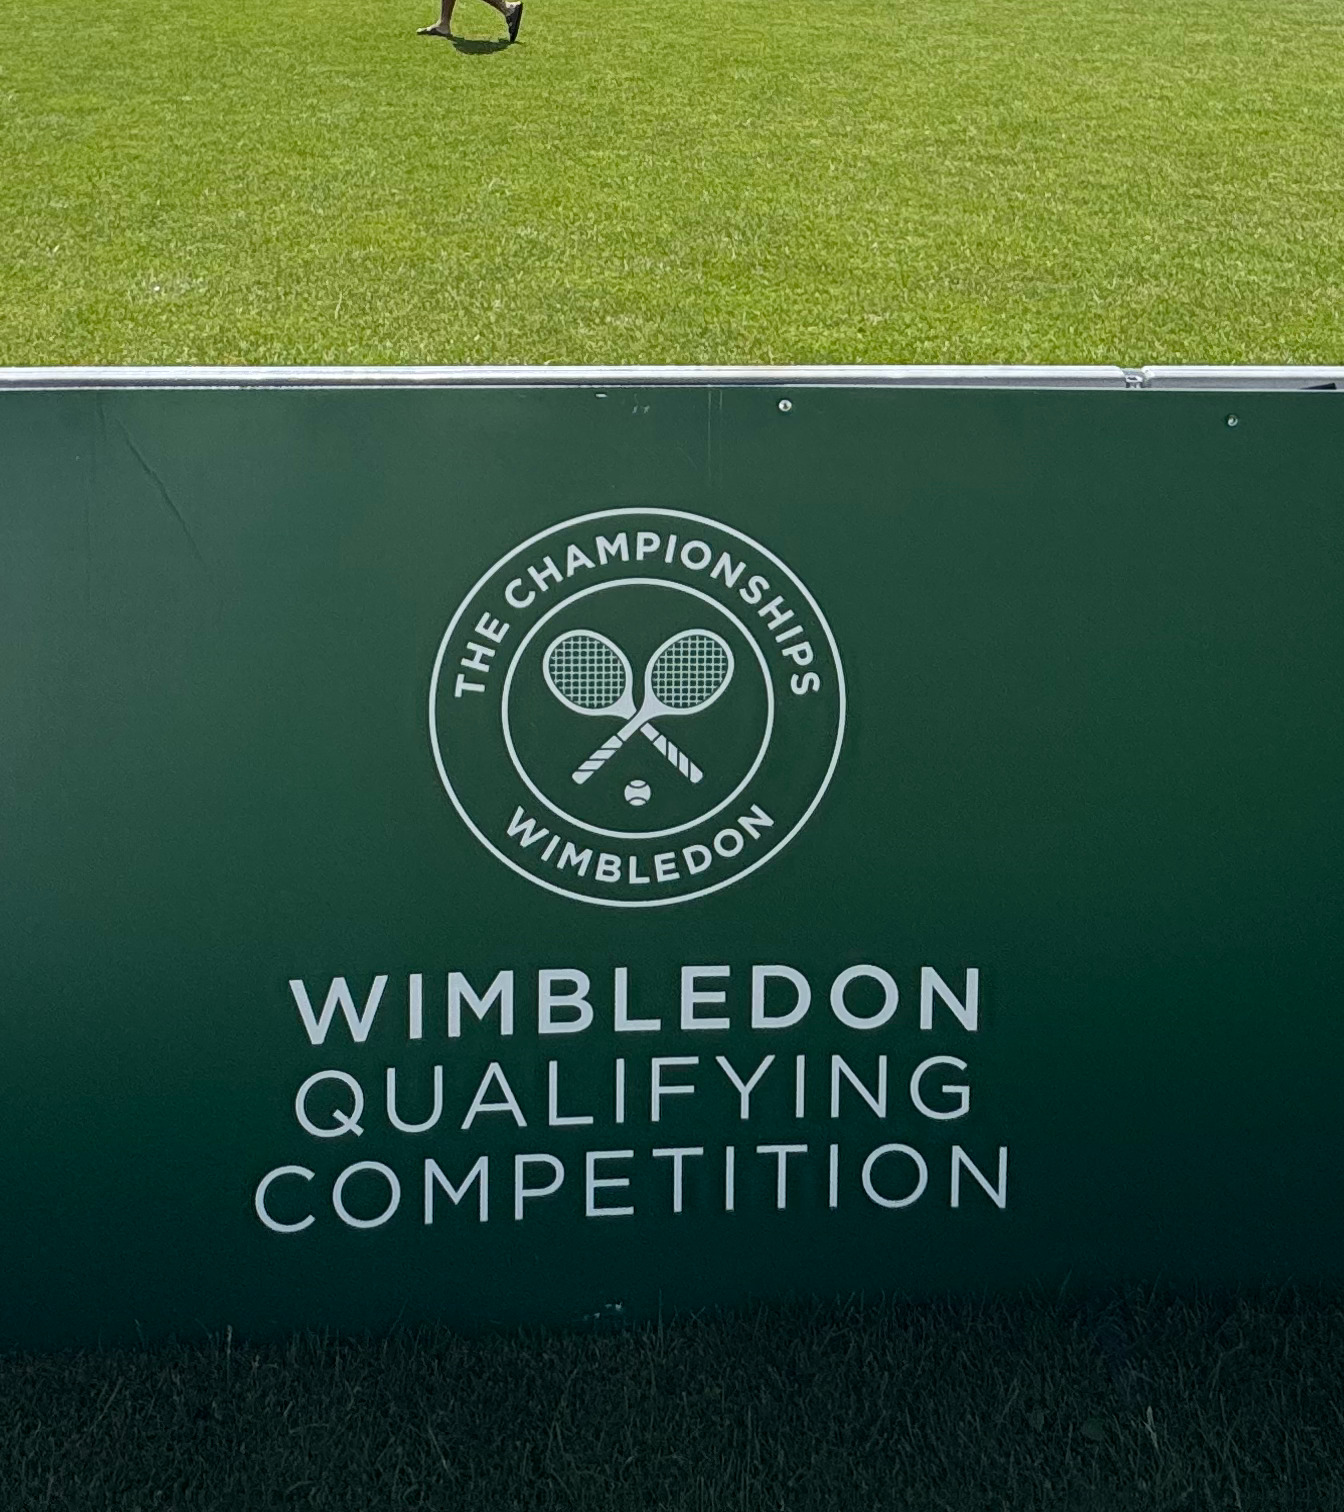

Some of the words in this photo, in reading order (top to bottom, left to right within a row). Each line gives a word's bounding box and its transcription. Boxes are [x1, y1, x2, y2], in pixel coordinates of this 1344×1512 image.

[454, 611, 510, 698] THE
[504, 531, 821, 696] CHAMPIONSHIPS
[506, 804, 775, 885] WIMBLEDON
[288, 964, 979, 1045] WIMBLEDON
[295, 1054, 970, 1138] QUALIFYING
[254, 1143, 1008, 1233] COMPETITION
